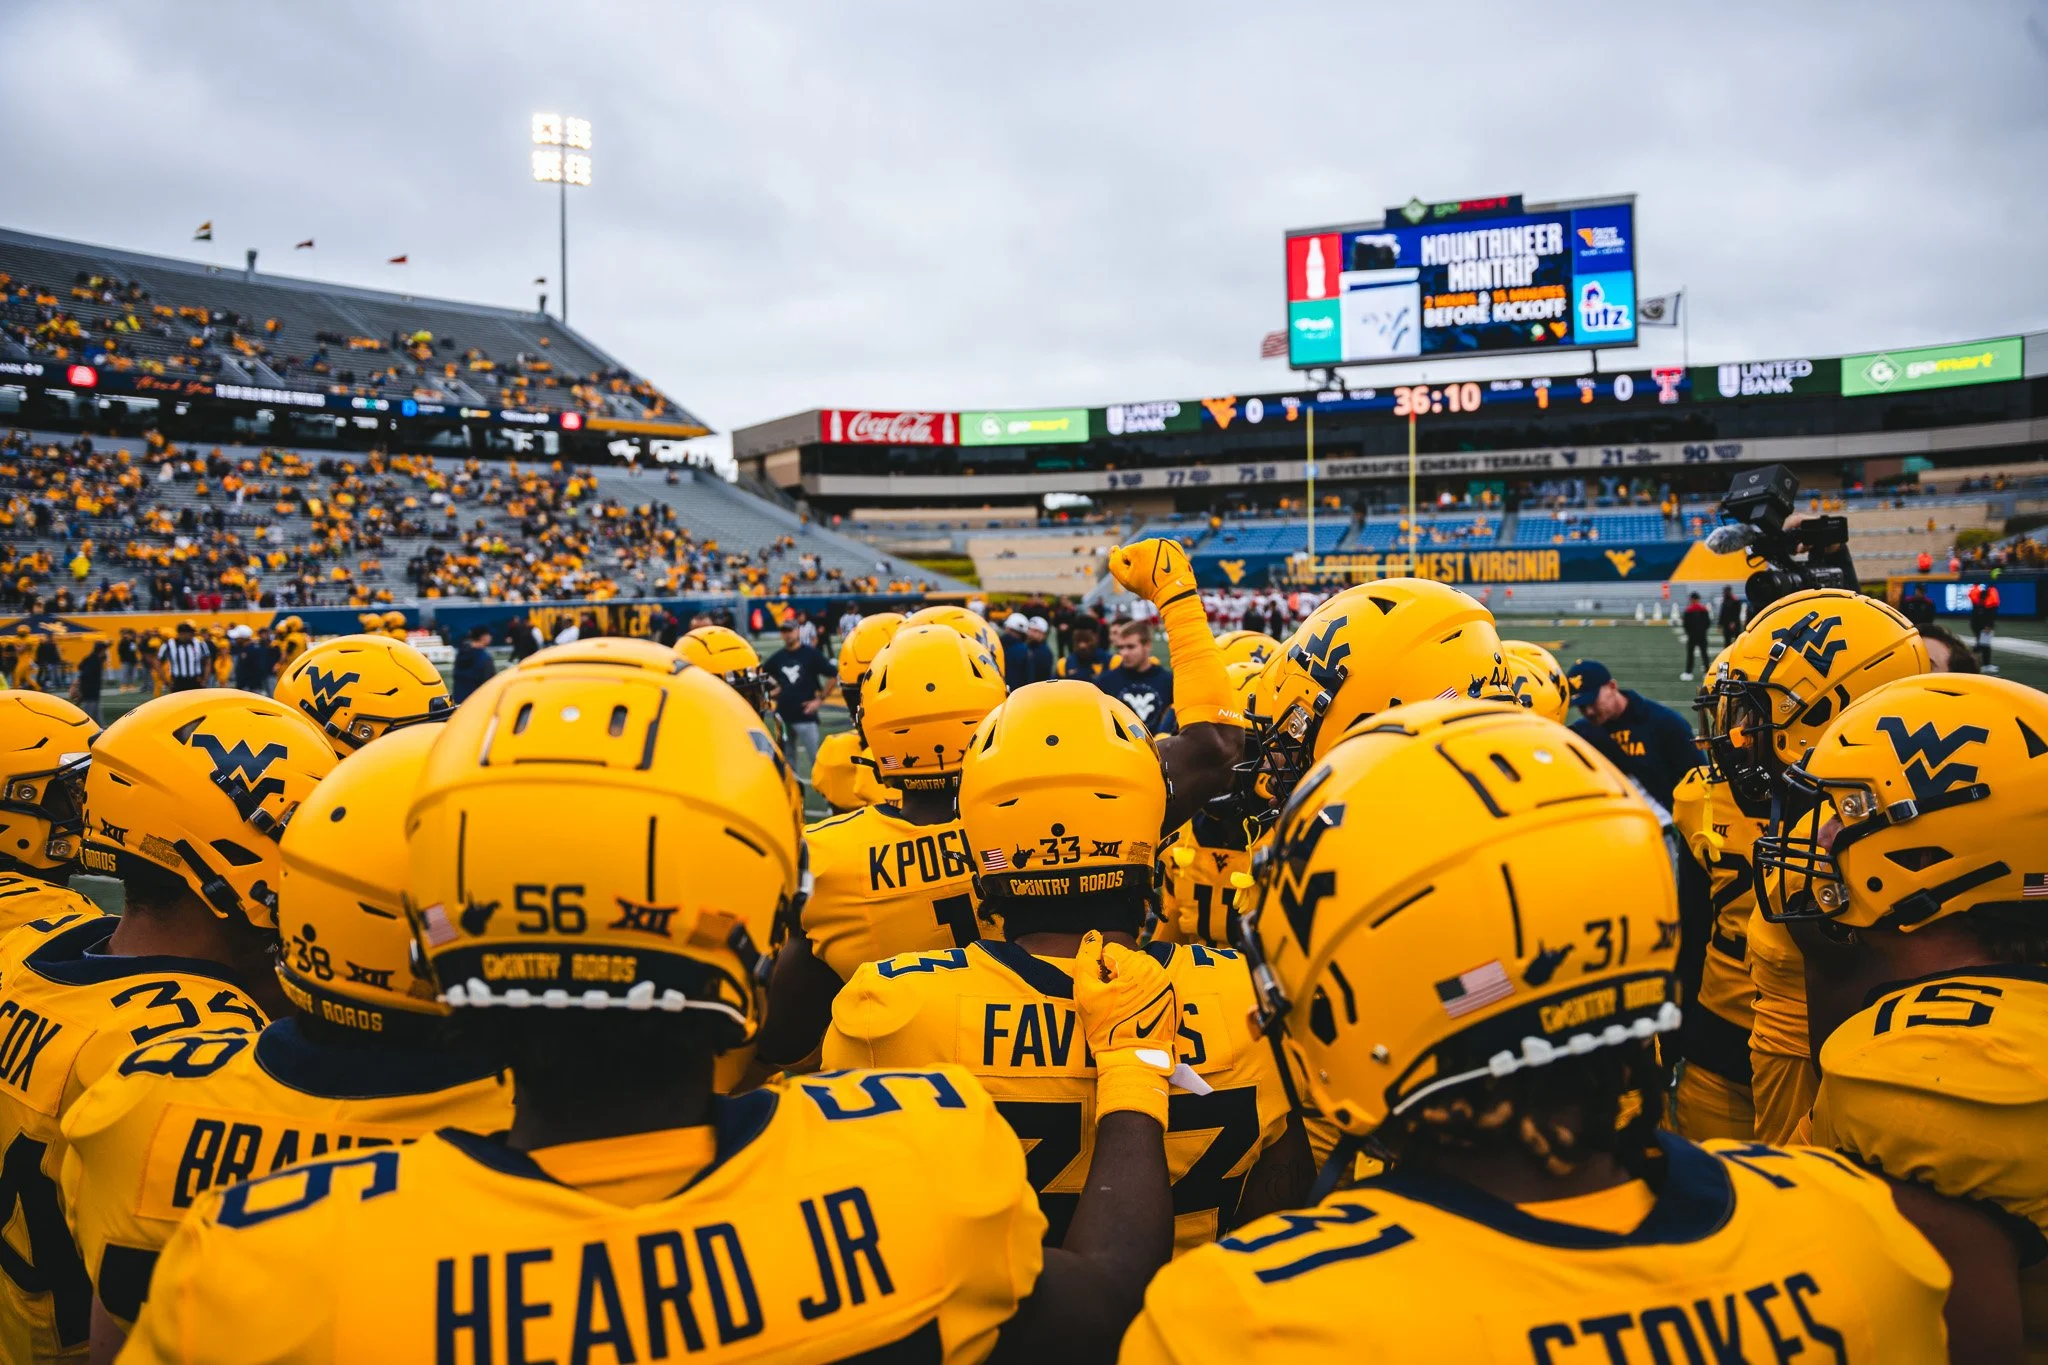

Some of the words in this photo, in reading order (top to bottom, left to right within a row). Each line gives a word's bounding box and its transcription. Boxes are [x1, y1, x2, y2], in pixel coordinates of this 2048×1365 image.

[1421, 223, 1562, 266] MOUNTAINEER
[1448, 254, 1538, 292] MANTRIP
[1741, 360, 1813, 379] UNITED
[1393, 382, 1482, 416] 36:10
[1613, 373, 1634, 402] 0
[1741, 377, 1793, 396] BANK
[847, 411, 934, 443] Coca-Cola
[1245, 398, 1264, 424] 0
[1327, 457, 1411, 477] DIVERSIFIE
[1682, 444, 1709, 464] 90
[1413, 551, 1466, 583] WEST
[1468, 549, 1561, 582] VIRGINIA
[1040, 836, 1081, 866] 33
[1089, 840, 1123, 858] XII
[1079, 870, 1124, 893] ROADS
[515, 884, 588, 935] 56
[608, 896, 681, 938] XII
[1583, 914, 1629, 973] 31
[293, 934, 335, 981] 38
[346, 960, 395, 991] XII
[321, 1000, 383, 1033] ROADS
[1873, 982, 2003, 1036] 15
[434, 1222, 766, 1365] HEARD
[799, 1186, 896, 1322] JR
